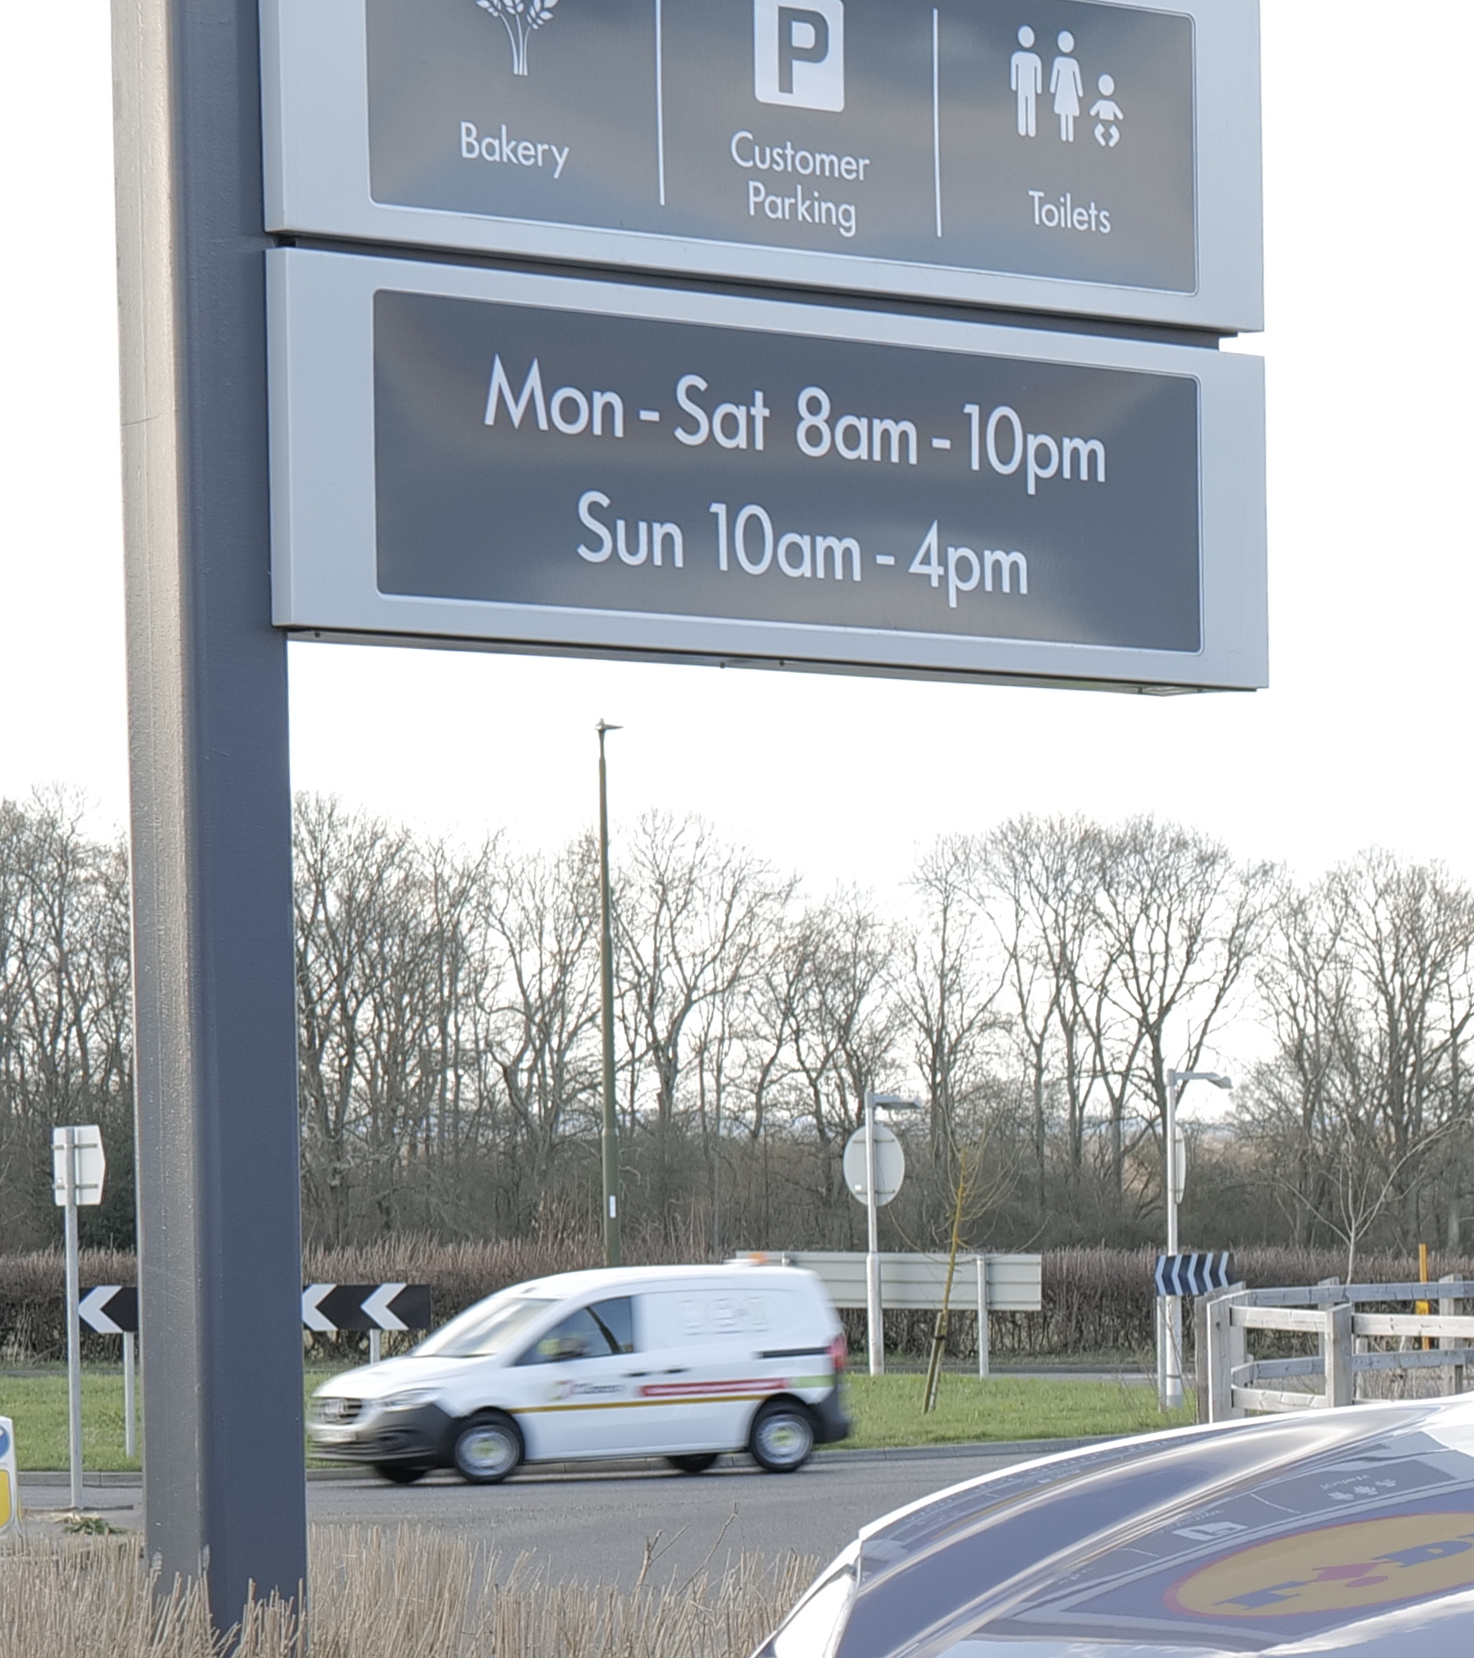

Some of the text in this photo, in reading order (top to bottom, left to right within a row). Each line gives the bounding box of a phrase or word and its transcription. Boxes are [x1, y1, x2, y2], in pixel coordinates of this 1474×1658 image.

[460, 122, 570, 180] Bakery
[729, 130, 870, 182] Customer
[747, 182, 857, 239] Parking
[1028, 190, 1112, 235] Toilets
[484, 353, 625, 438] Mon
[674, 375, 771, 452] Sat
[796, 387, 918, 466] 8am
[964, 405, 1107, 496] 10pm
[576, 490, 686, 570] Sun
[708, 503, 863, 583] 10am
[908, 519, 1029, 609] 4pm
